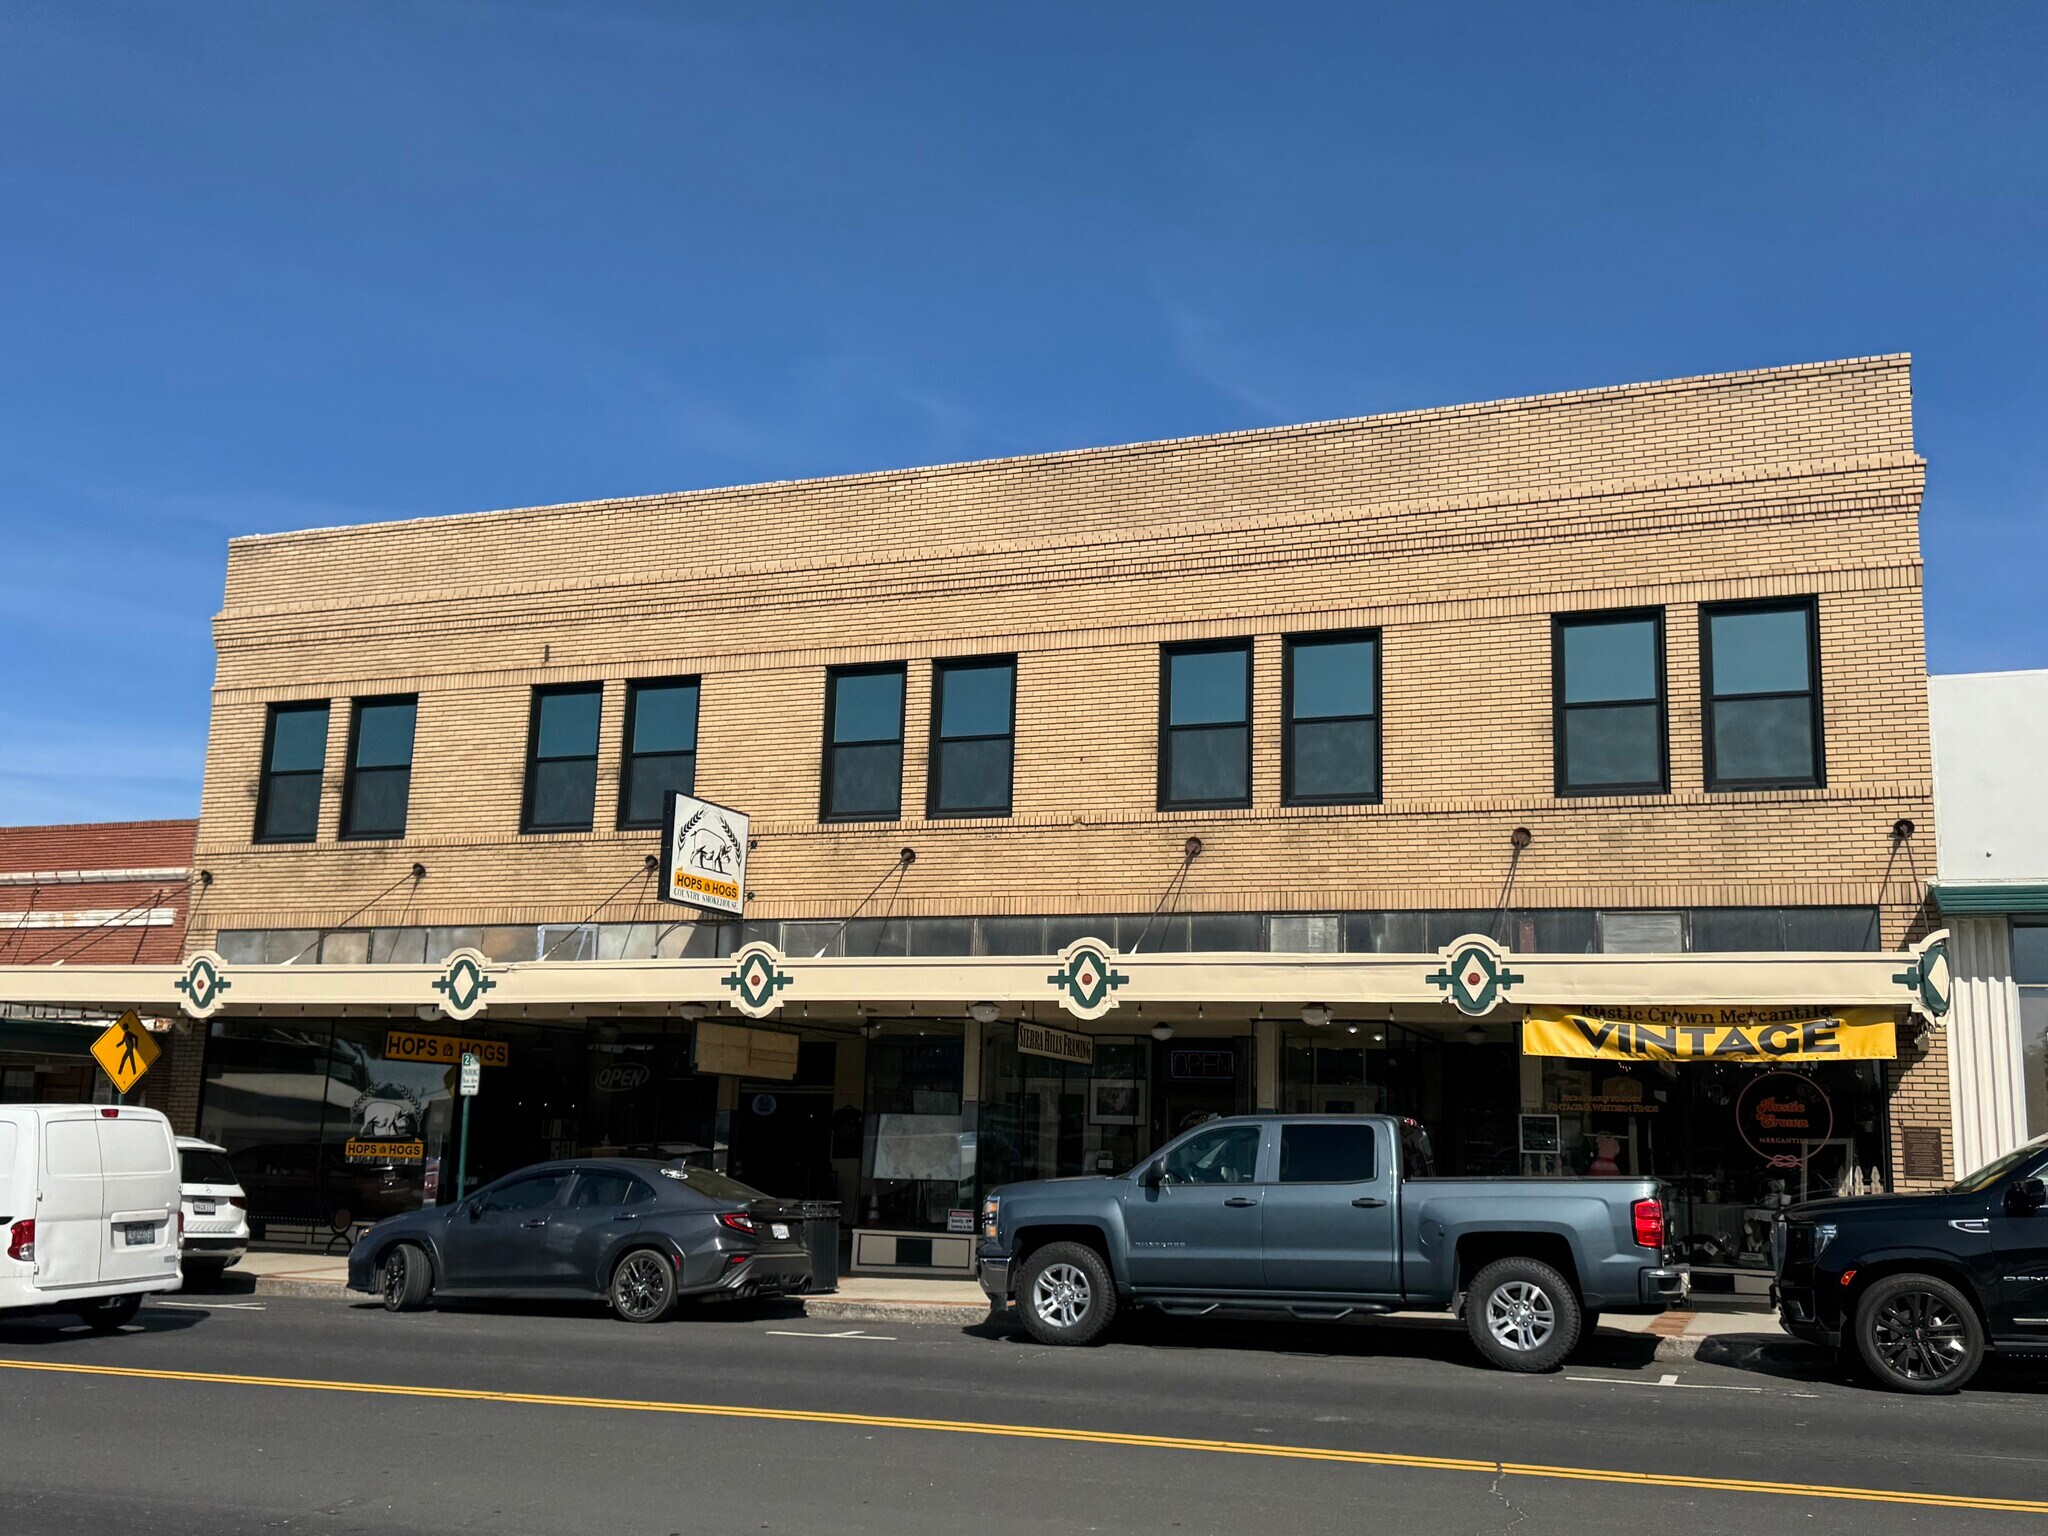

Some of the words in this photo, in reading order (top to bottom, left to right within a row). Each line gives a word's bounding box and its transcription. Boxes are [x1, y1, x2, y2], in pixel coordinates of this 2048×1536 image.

[677, 874, 702, 891] HOPS
[712, 884, 737, 899] HOGS
[673, 887, 700, 901] COUNTRY
[702, 894, 738, 910] SMOKEHOUSE
[1581, 1005, 1643, 1021] Rustic
[1648, 1007, 1714, 1025] Crown
[1719, 1005, 1831, 1024] Mercantile
[1019, 1025, 1043, 1051] SIERRA
[1044, 1030, 1063, 1055] HILLS
[1063, 1034, 1091, 1060] FRAMING
[1573, 1018, 1841, 1056] VINTAGE
[387, 1035, 438, 1057] HOPS
[459, 1041, 506, 1063] HOGS
[1174, 1053, 1231, 1076] OPEN
[598, 1067, 644, 1088] OPEN
[348, 1144, 377, 1154] HOPS
[389, 1145, 420, 1155] HOGS
